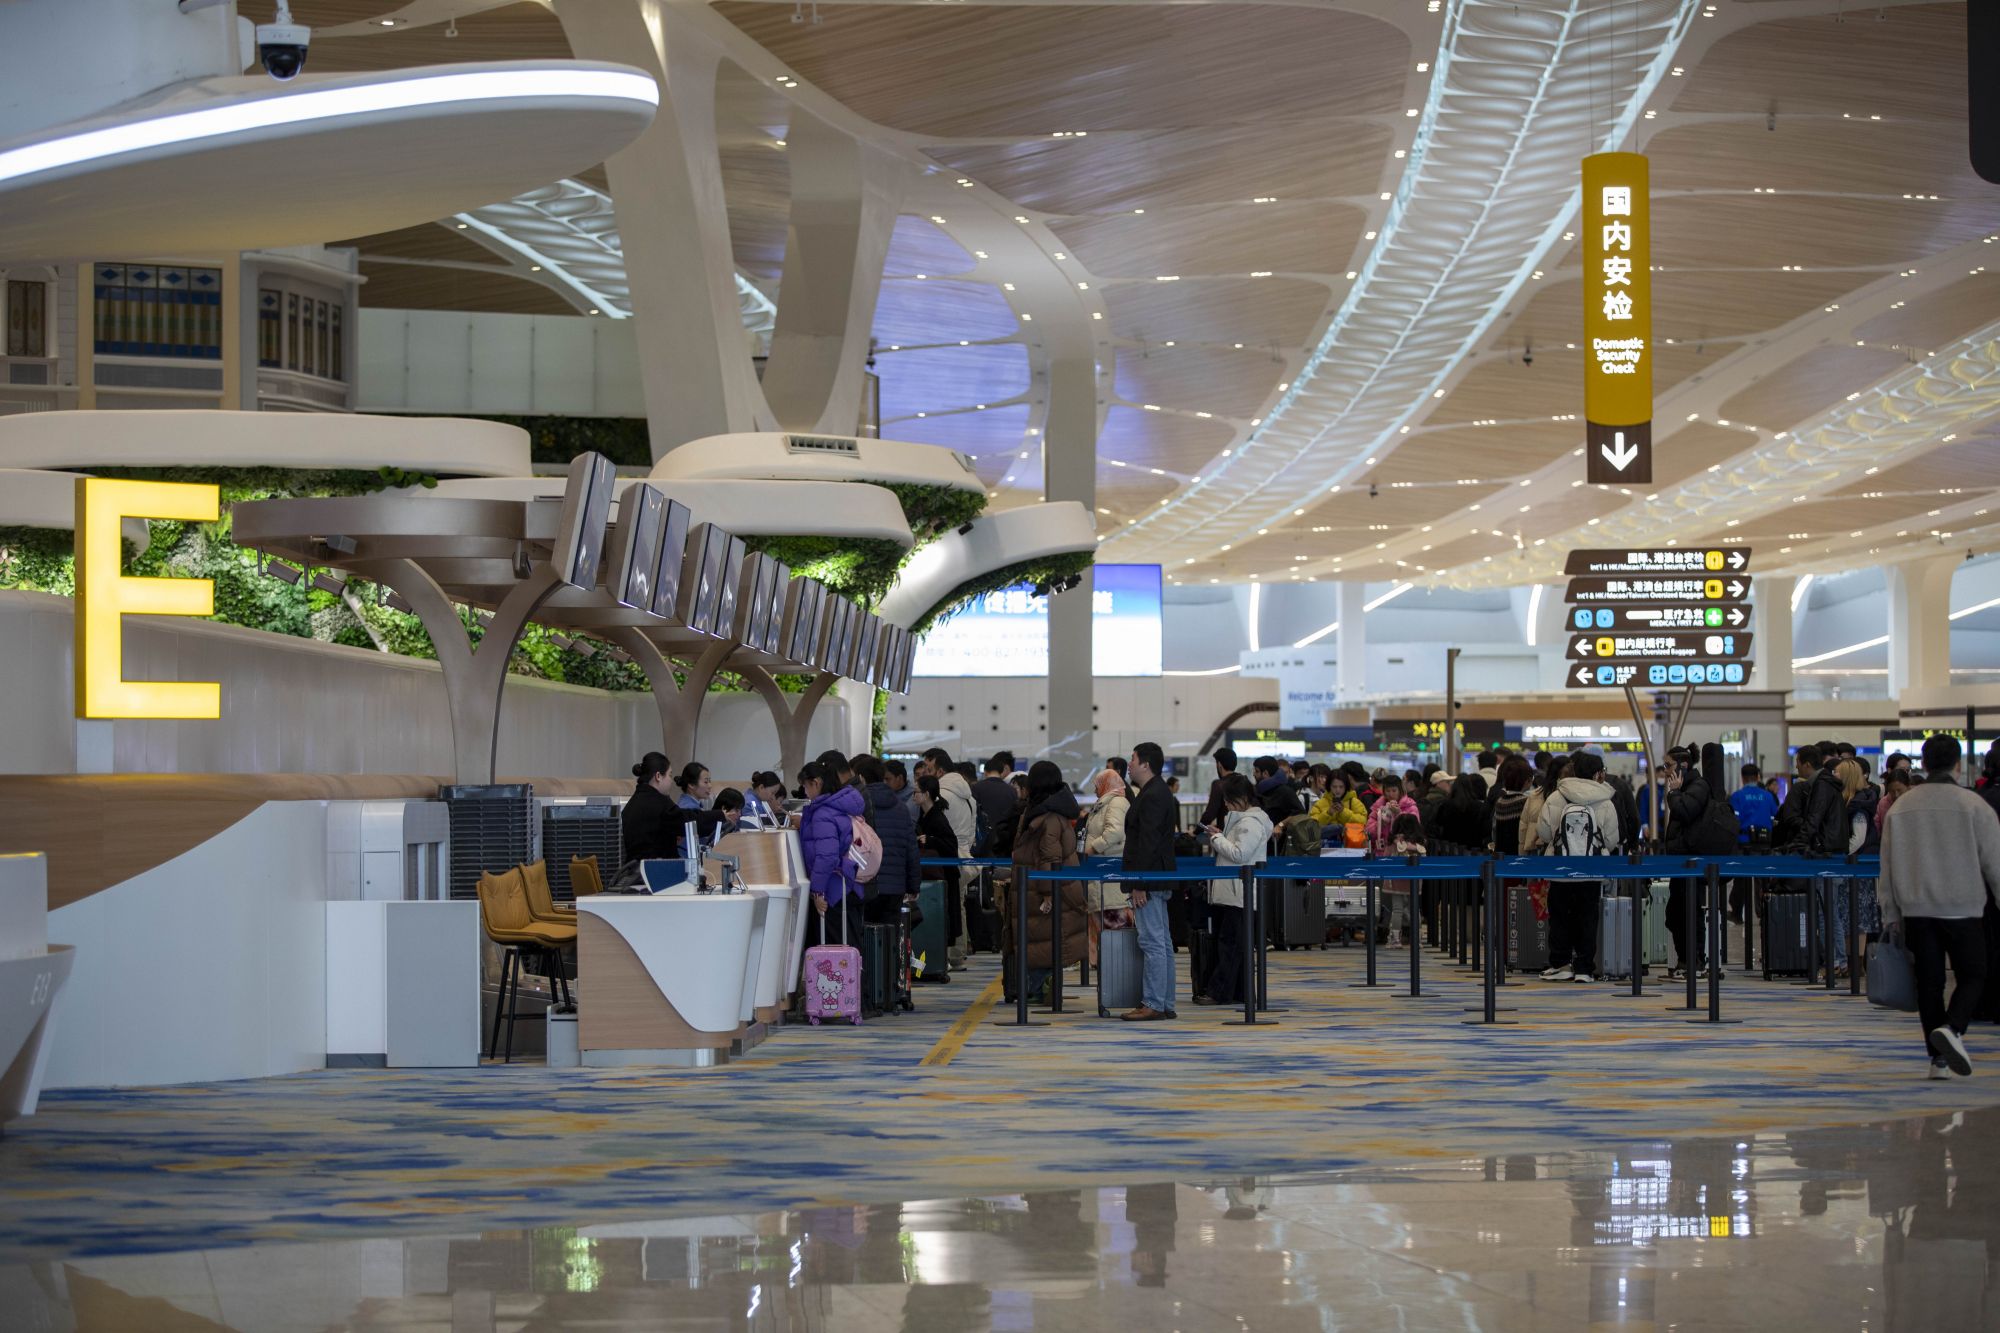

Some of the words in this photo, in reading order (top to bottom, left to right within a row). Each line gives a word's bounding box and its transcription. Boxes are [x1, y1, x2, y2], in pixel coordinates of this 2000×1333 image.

[1603, 187, 1632, 320] 国内安检
[1593, 337, 1644, 350] Domestic
[1597, 350, 1640, 363] Security
[1602, 362, 1636, 374] Check
[76, 477, 221, 719] E
[1671, 648, 1696, 656] Baggage
